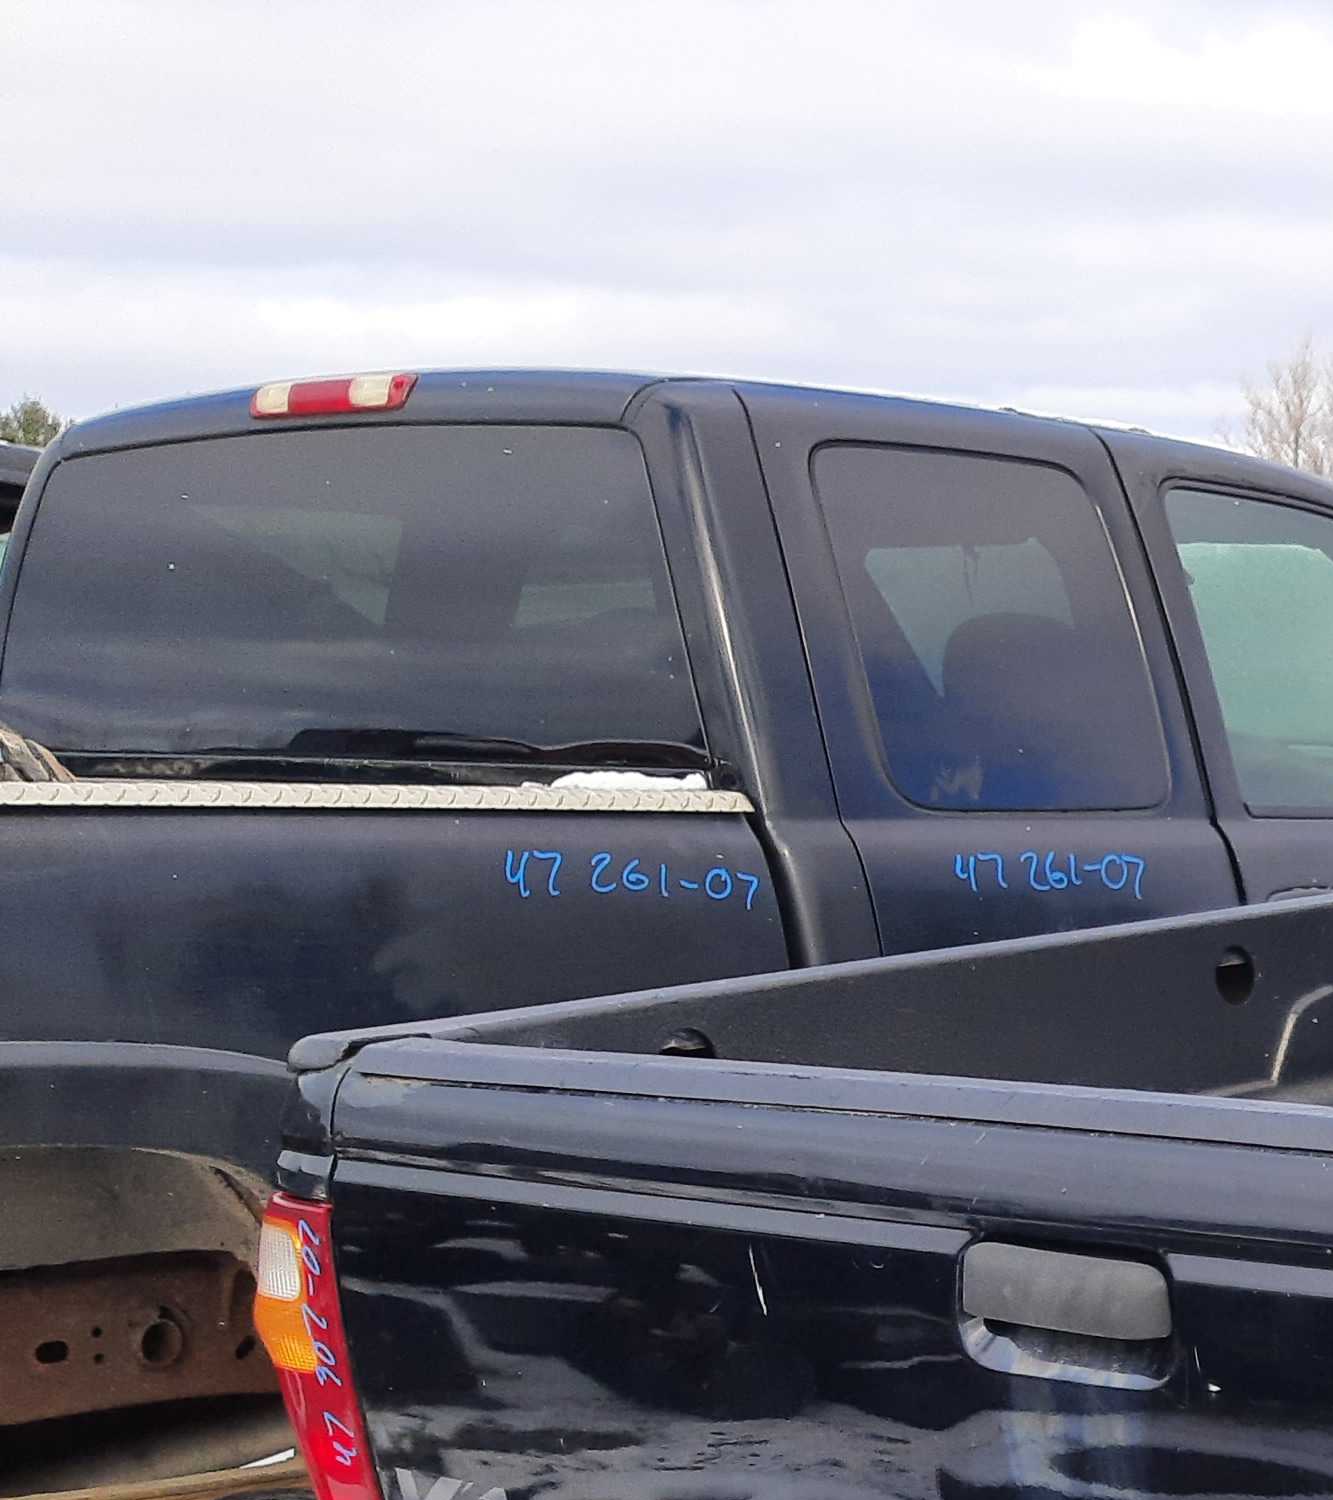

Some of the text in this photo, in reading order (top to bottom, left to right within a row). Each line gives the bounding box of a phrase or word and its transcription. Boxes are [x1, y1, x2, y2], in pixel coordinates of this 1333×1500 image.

[503, 848, 763, 909] 47 261-07
[951, 847, 1149, 899] 47 261-07
[297, 1218, 359, 1467] 47 307-07
